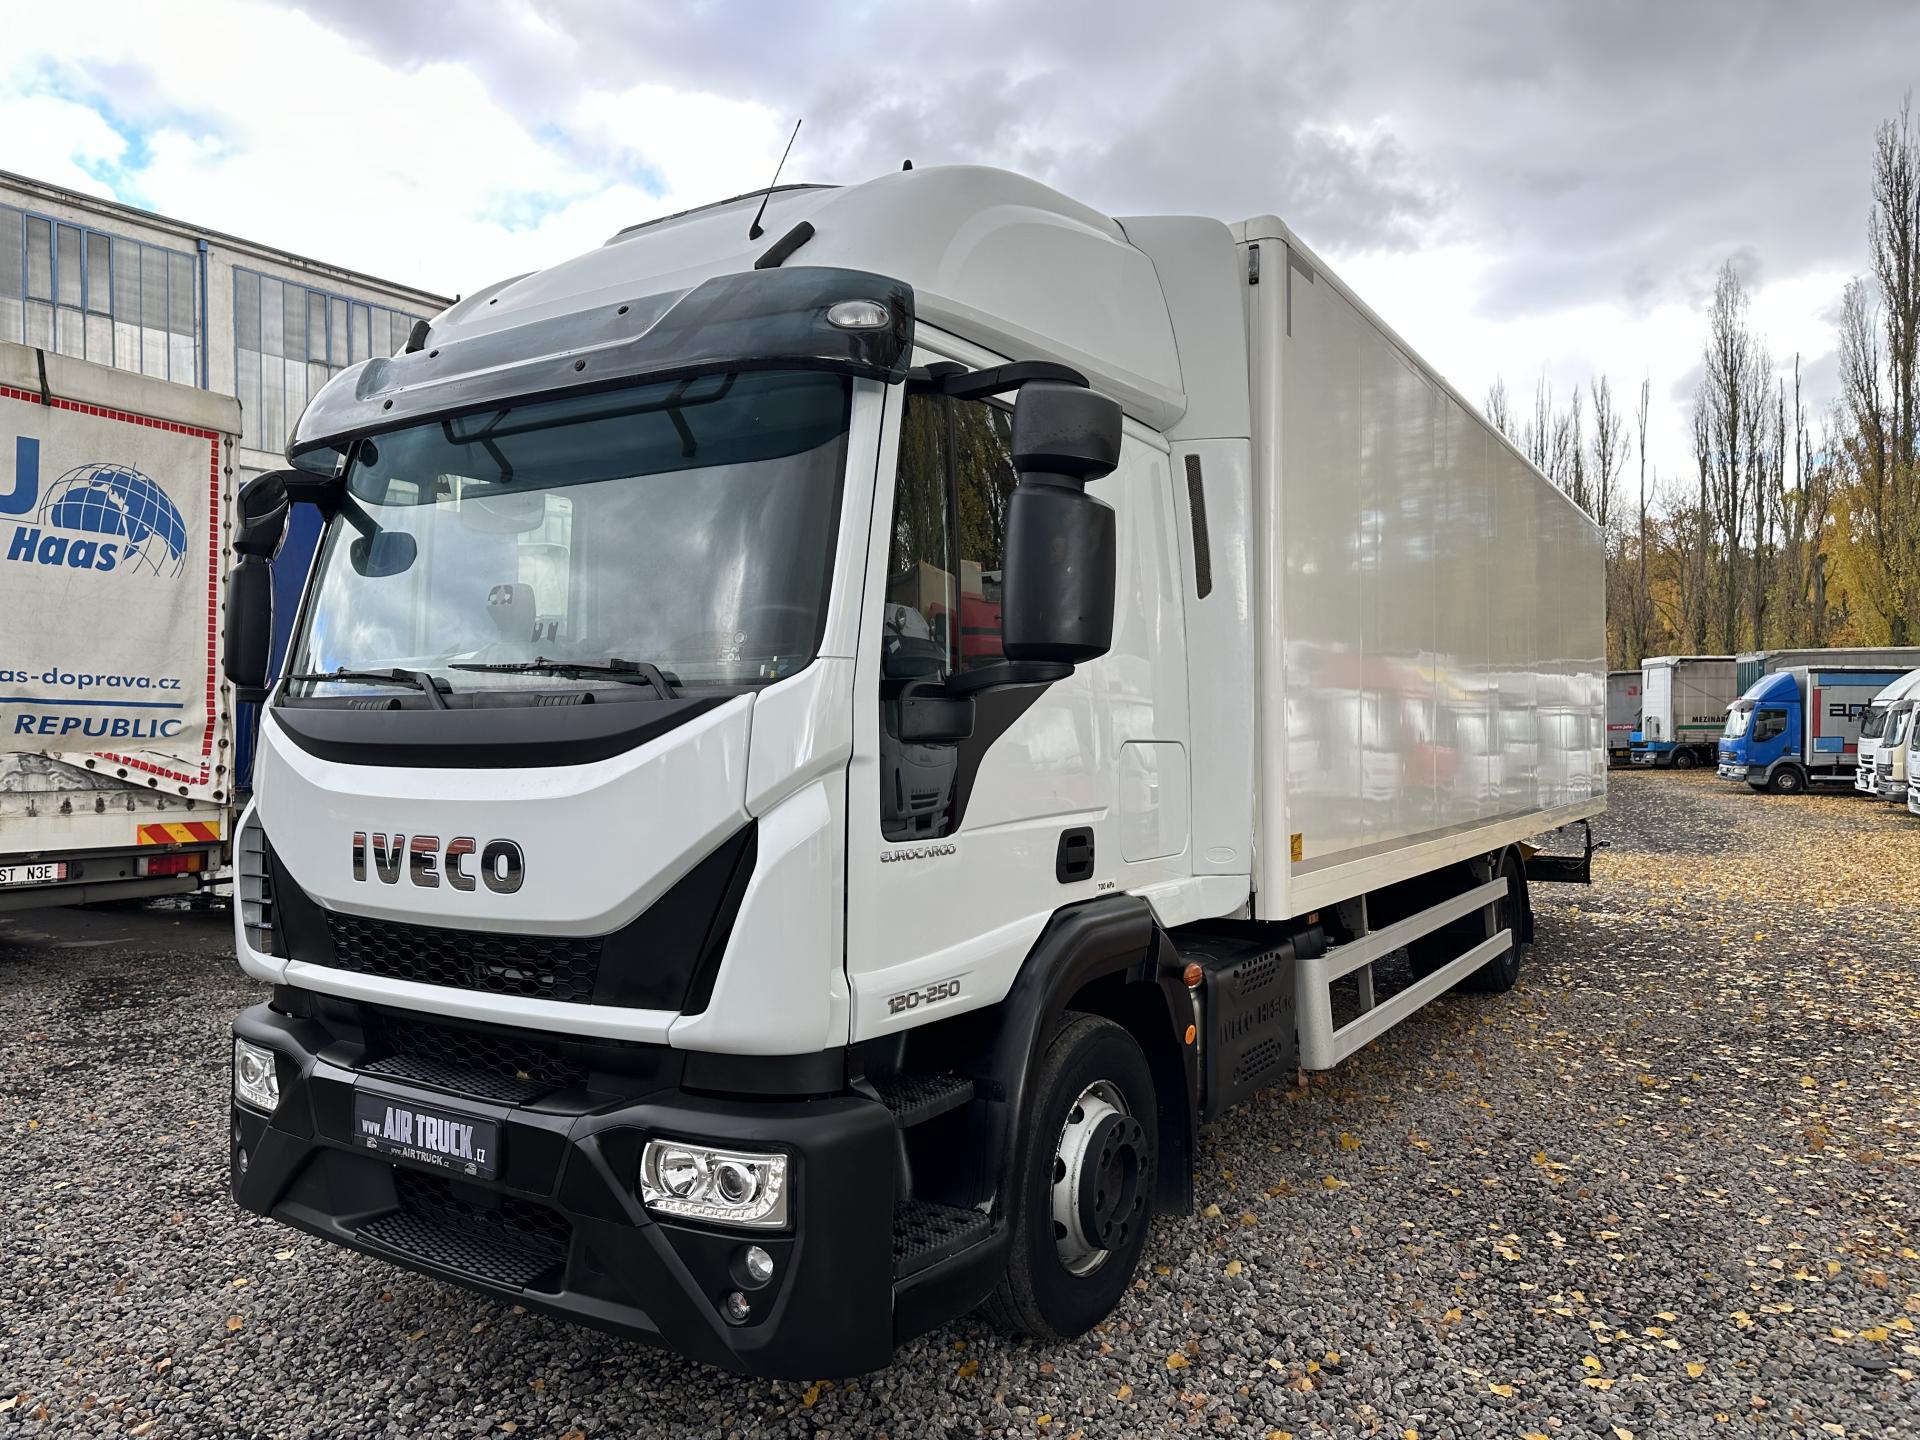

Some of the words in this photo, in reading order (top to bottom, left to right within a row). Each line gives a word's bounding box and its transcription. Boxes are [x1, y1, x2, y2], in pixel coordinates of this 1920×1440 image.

[7, 526, 118, 572] Haas
[14, 714, 182, 738] REPUBLIC
[352, 831, 526, 895] IVECO
[880, 843, 956, 863] EUROCARGO
[27, 865, 53, 880] N3E
[888, 979, 960, 1014] 120-250
